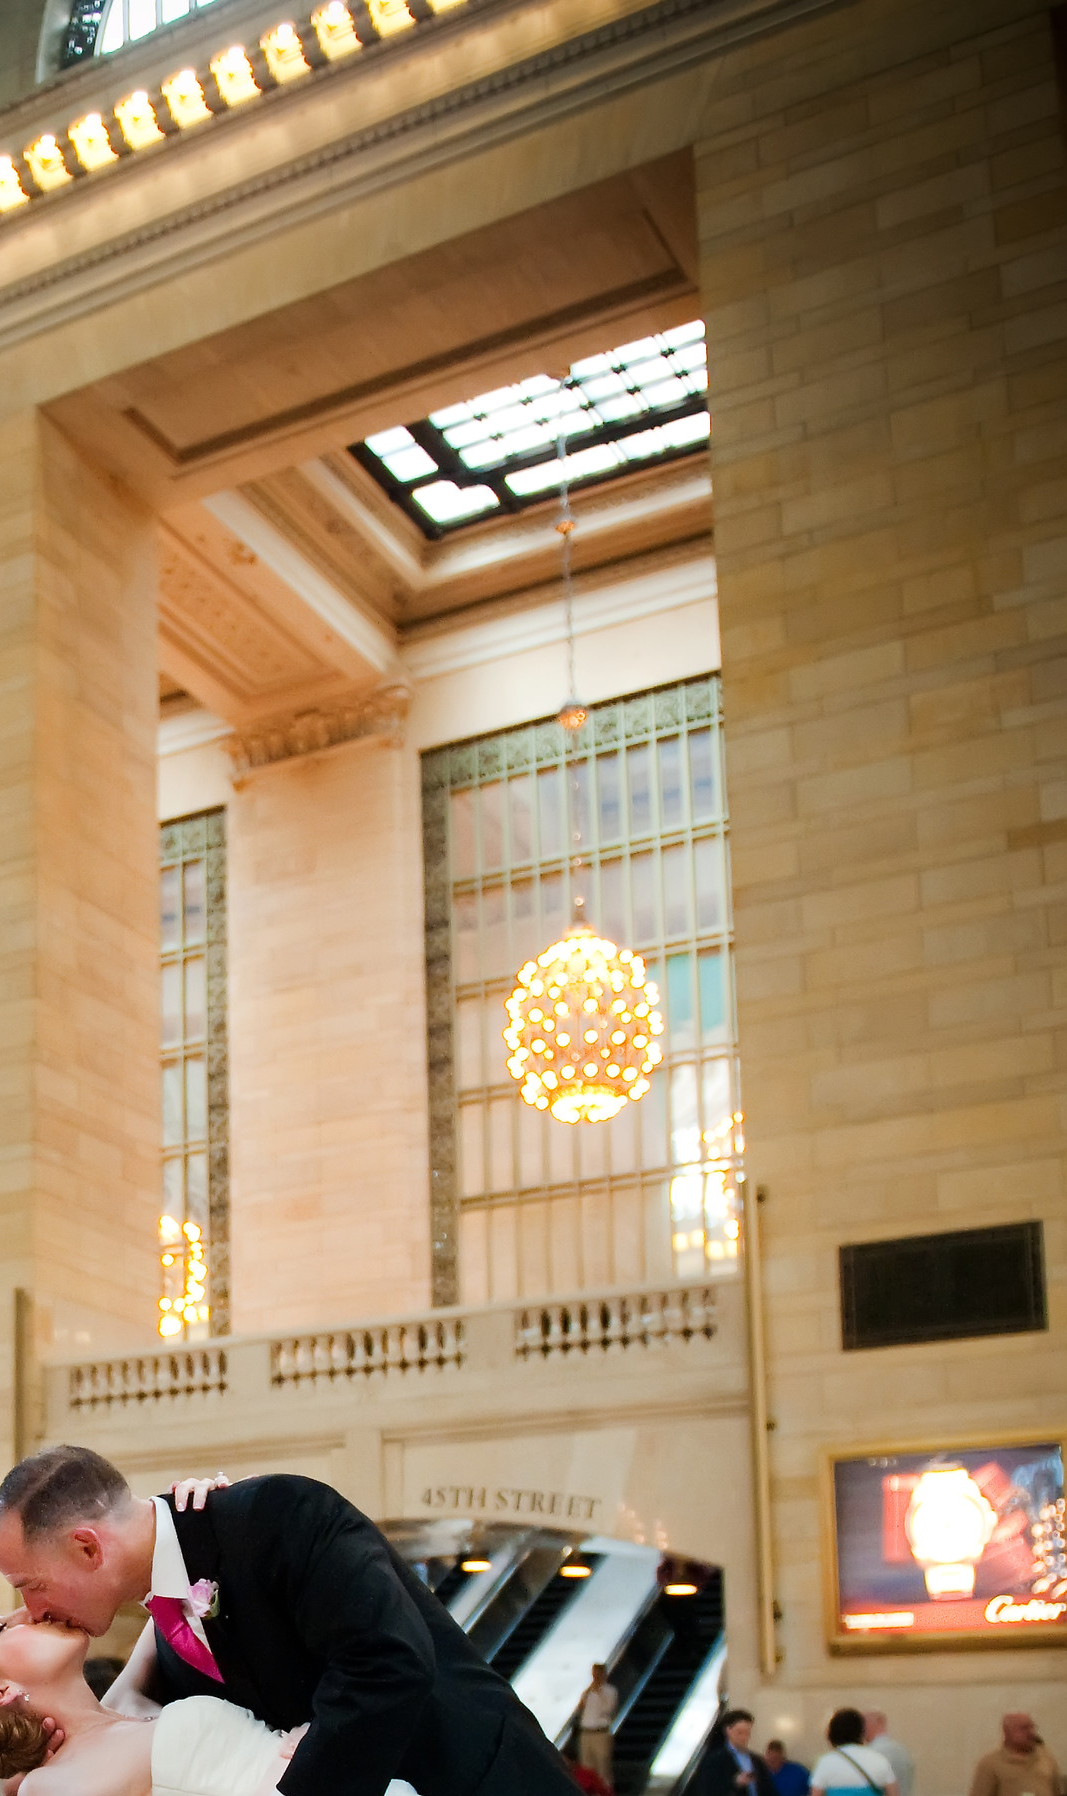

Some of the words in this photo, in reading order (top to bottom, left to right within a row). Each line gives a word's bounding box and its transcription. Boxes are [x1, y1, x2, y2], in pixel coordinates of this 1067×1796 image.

[422, 1485, 487, 1509] 45TH
[493, 1488, 603, 1519] STREET
[984, 1594, 1066, 1624] Cartier
